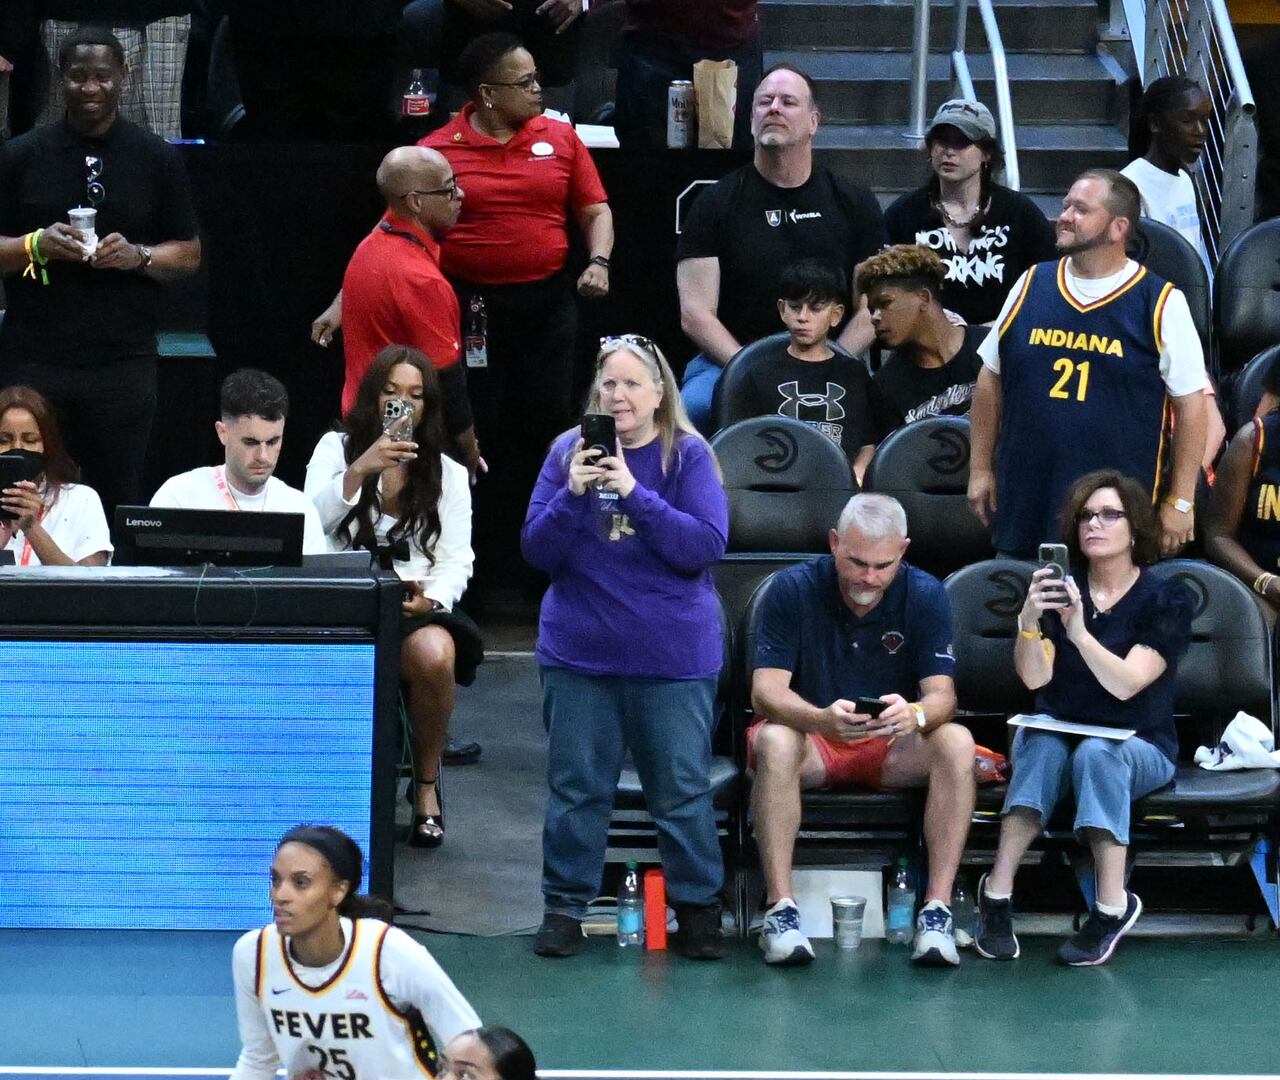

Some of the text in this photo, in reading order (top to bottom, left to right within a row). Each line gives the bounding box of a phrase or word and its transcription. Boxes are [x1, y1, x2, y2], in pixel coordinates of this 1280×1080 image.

[1029, 328, 1123, 358] INDIANA
[1049, 358, 1090, 402] 21
[126, 517, 162, 527] Lenovo
[271, 1008, 374, 1039] FEVER
